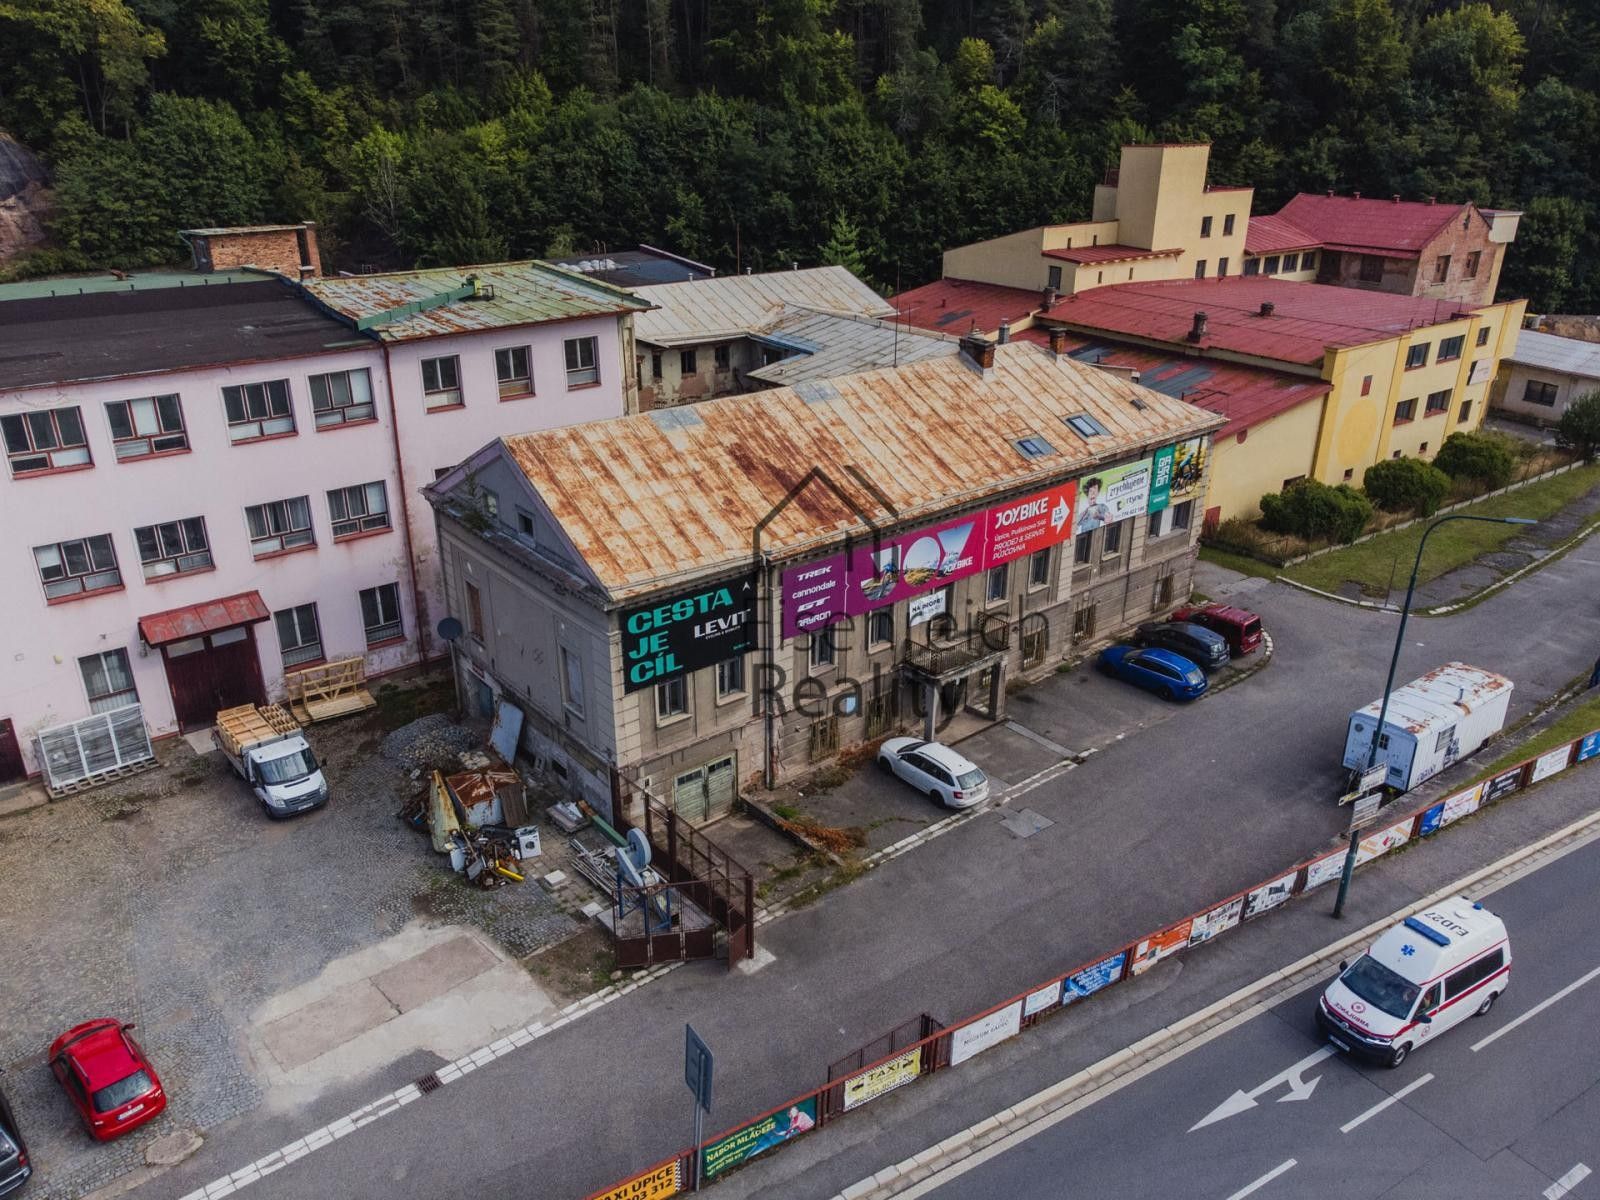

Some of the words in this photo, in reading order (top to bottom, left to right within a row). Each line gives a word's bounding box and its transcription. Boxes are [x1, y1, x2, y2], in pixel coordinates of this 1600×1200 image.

[993, 536, 1018, 552] PRODEJ
[1024, 528, 1046, 542] SERVIS
[797, 565, 832, 582] TREK
[792, 579, 836, 600] cannondale
[627, 588, 734, 634] CESTA
[797, 596, 832, 613] GT
[694, 608, 752, 639] LEVIT
[628, 630, 670, 659] JE
[630, 651, 684, 683] CÍL
[1424, 911, 1469, 937] EJD27
[868, 1062, 900, 1081] TAXI
[706, 1140, 736, 1163] NÁBOR
[631, 1165, 673, 1193] ÚPICE
[652, 1178, 673, 1196] 312
